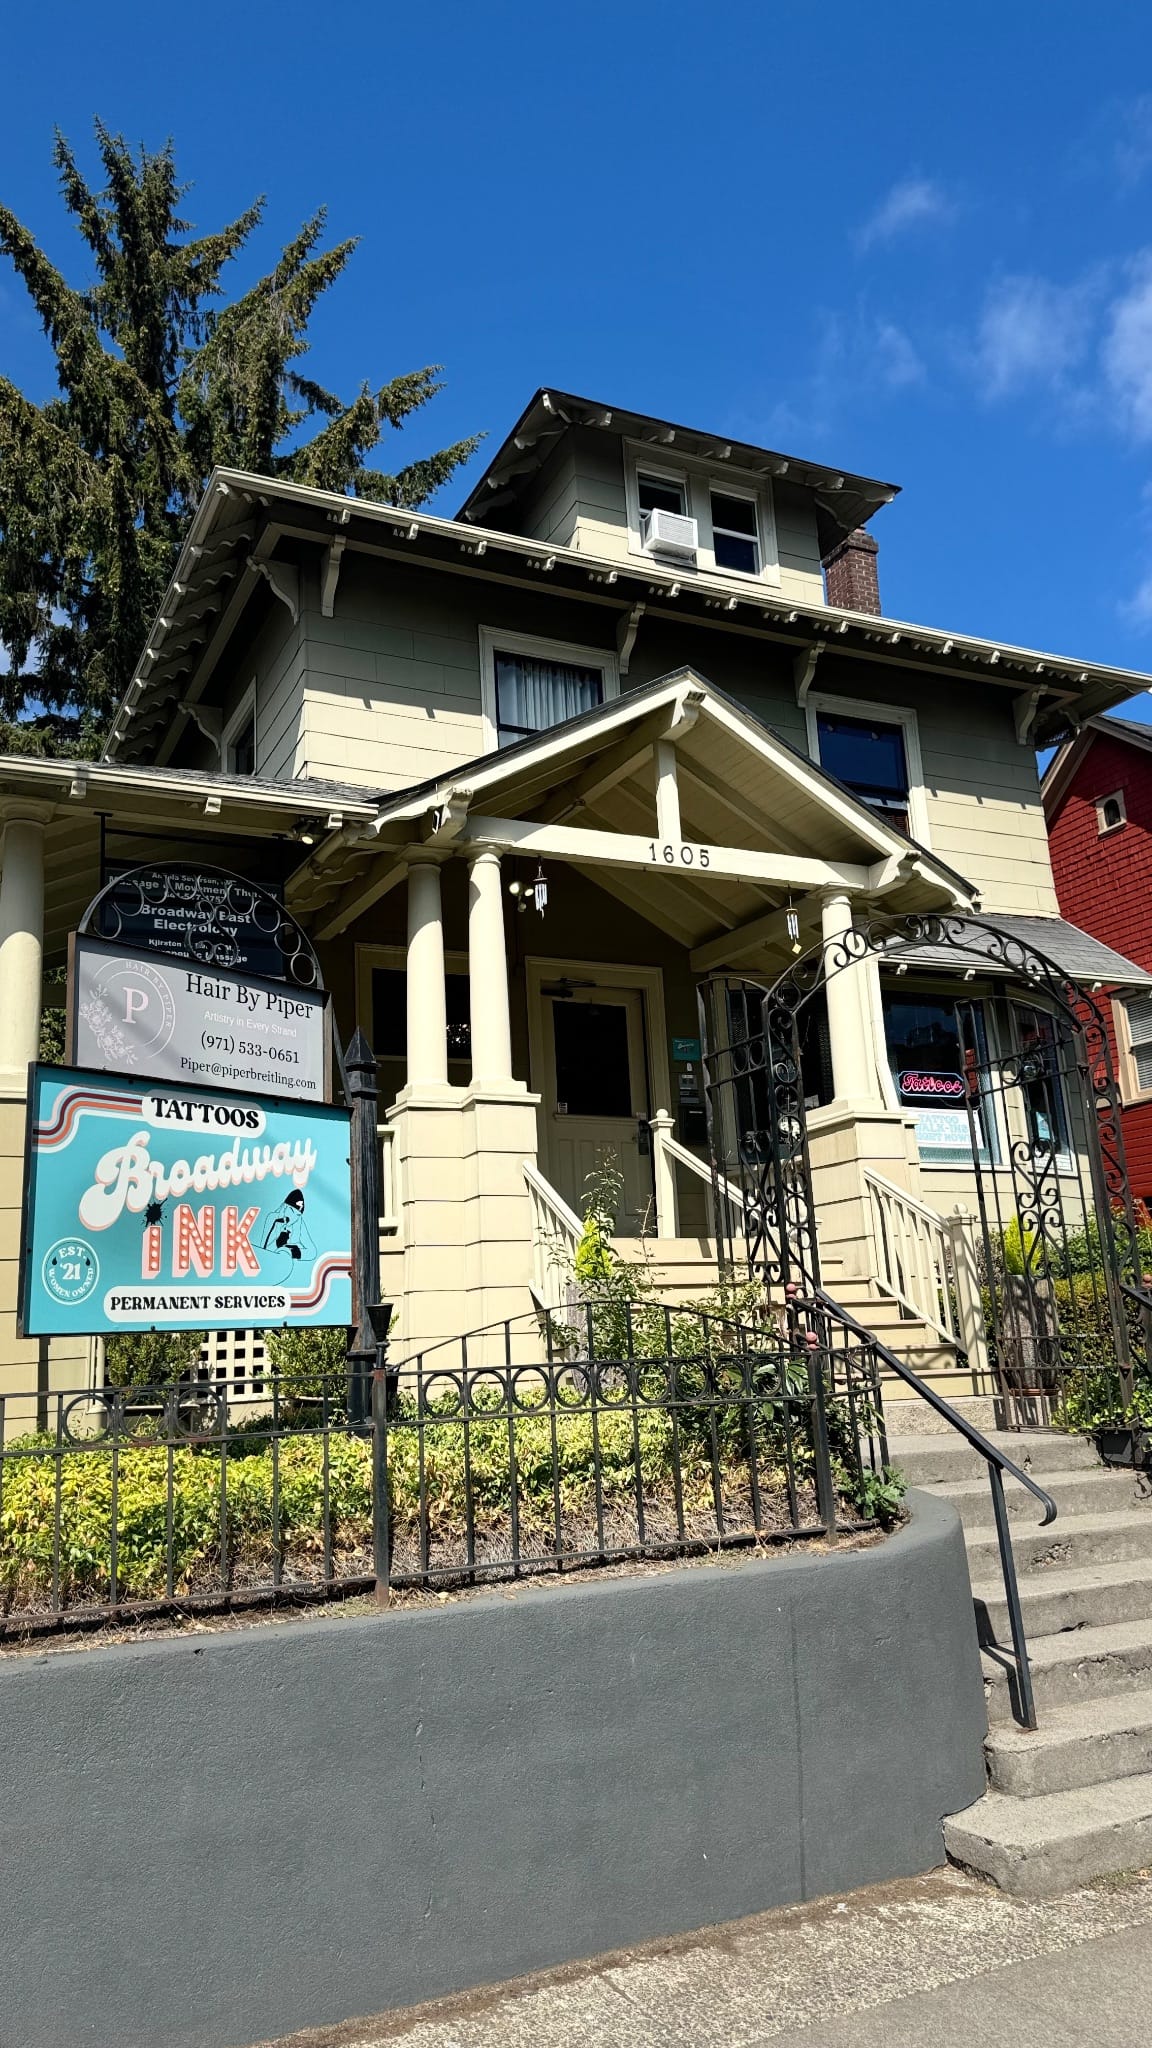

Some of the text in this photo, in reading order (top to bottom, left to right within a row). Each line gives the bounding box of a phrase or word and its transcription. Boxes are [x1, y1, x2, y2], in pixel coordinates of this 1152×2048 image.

[649, 842, 710, 868] 1605
[141, 905, 251, 924] Broadway East
[125, 961, 151, 976] HAIR
[121, 986, 149, 1024] P
[186, 972, 313, 1019] Hair By Piper
[204, 1010, 297, 1038] Artistry in Every Strand
[201, 1030, 300, 1064] (971) 533-0651
[180, 1056, 317, 1089] Piper@piperbreitling.com
[150, 1097, 259, 1129] TATTOOS
[79, 1131, 317, 1231] Broadway
[58, 1246, 87, 1259] EST.
[110, 1295, 286, 1311] PERMANENT SERVICES
